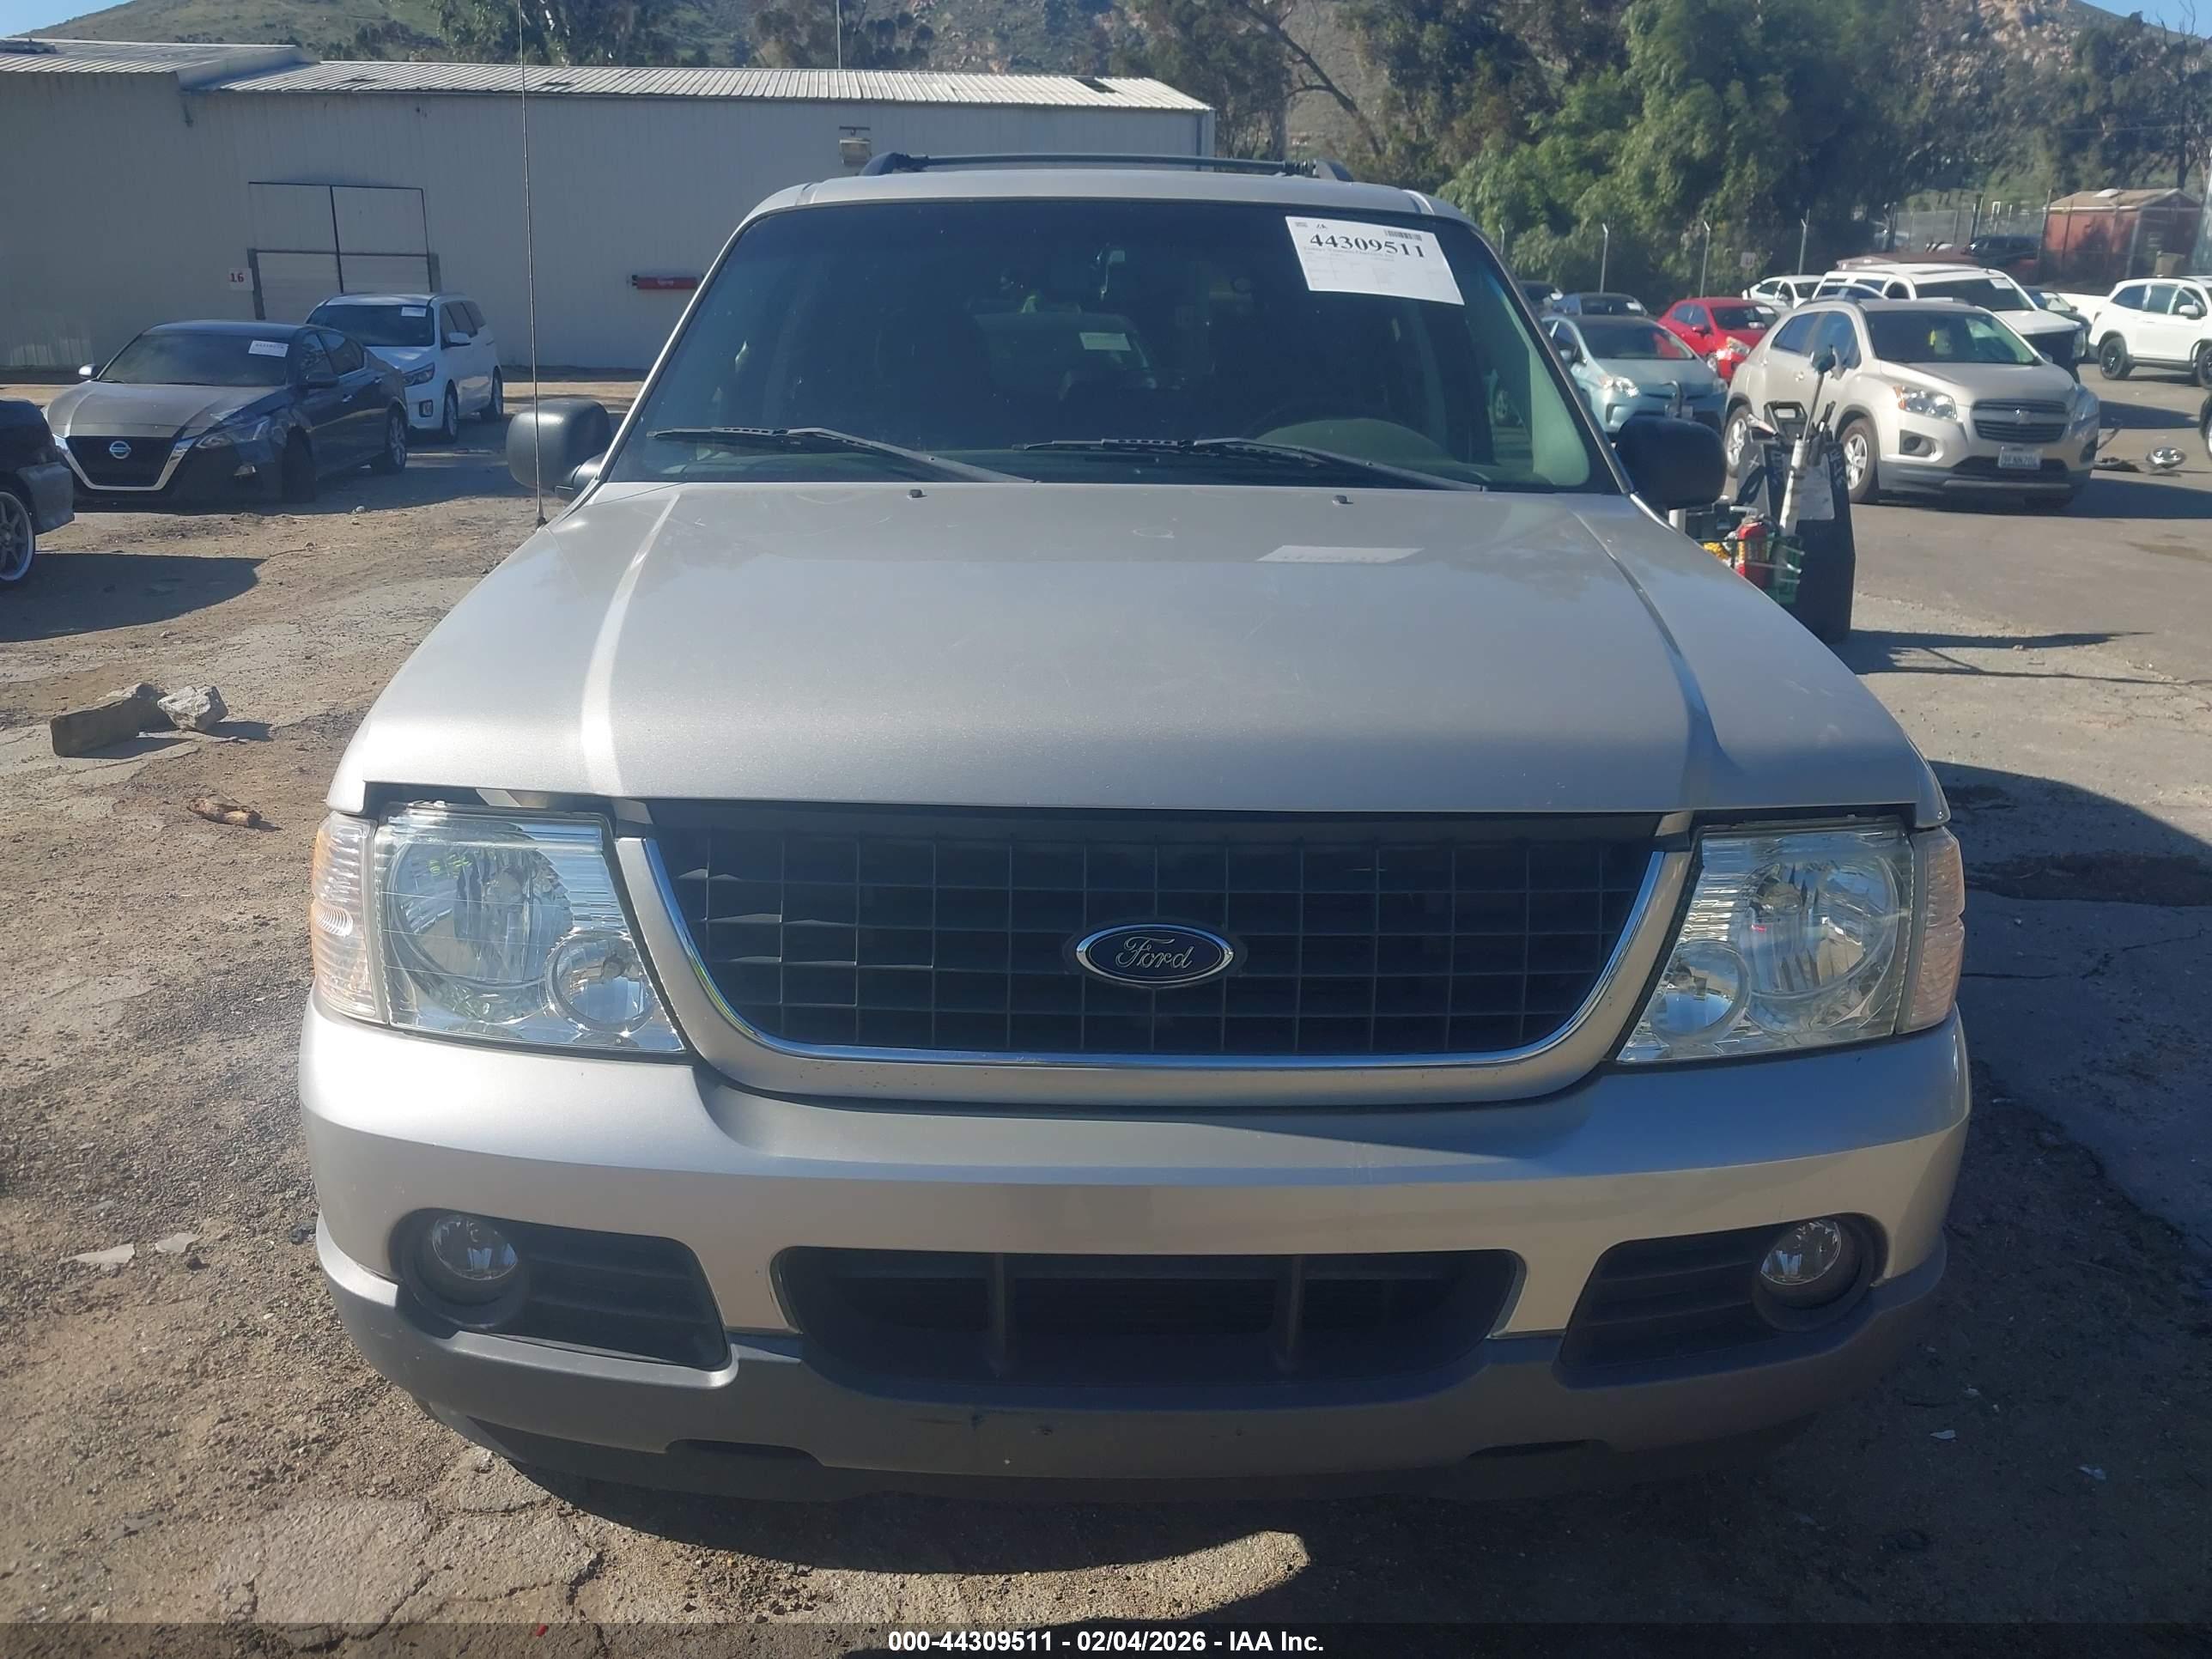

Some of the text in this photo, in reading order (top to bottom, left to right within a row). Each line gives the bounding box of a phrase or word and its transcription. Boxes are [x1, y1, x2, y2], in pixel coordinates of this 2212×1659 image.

[1310, 234, 1425, 258] 44309511
[229, 272, 245, 283] 16
[1115, 935, 1194, 969] Ford
